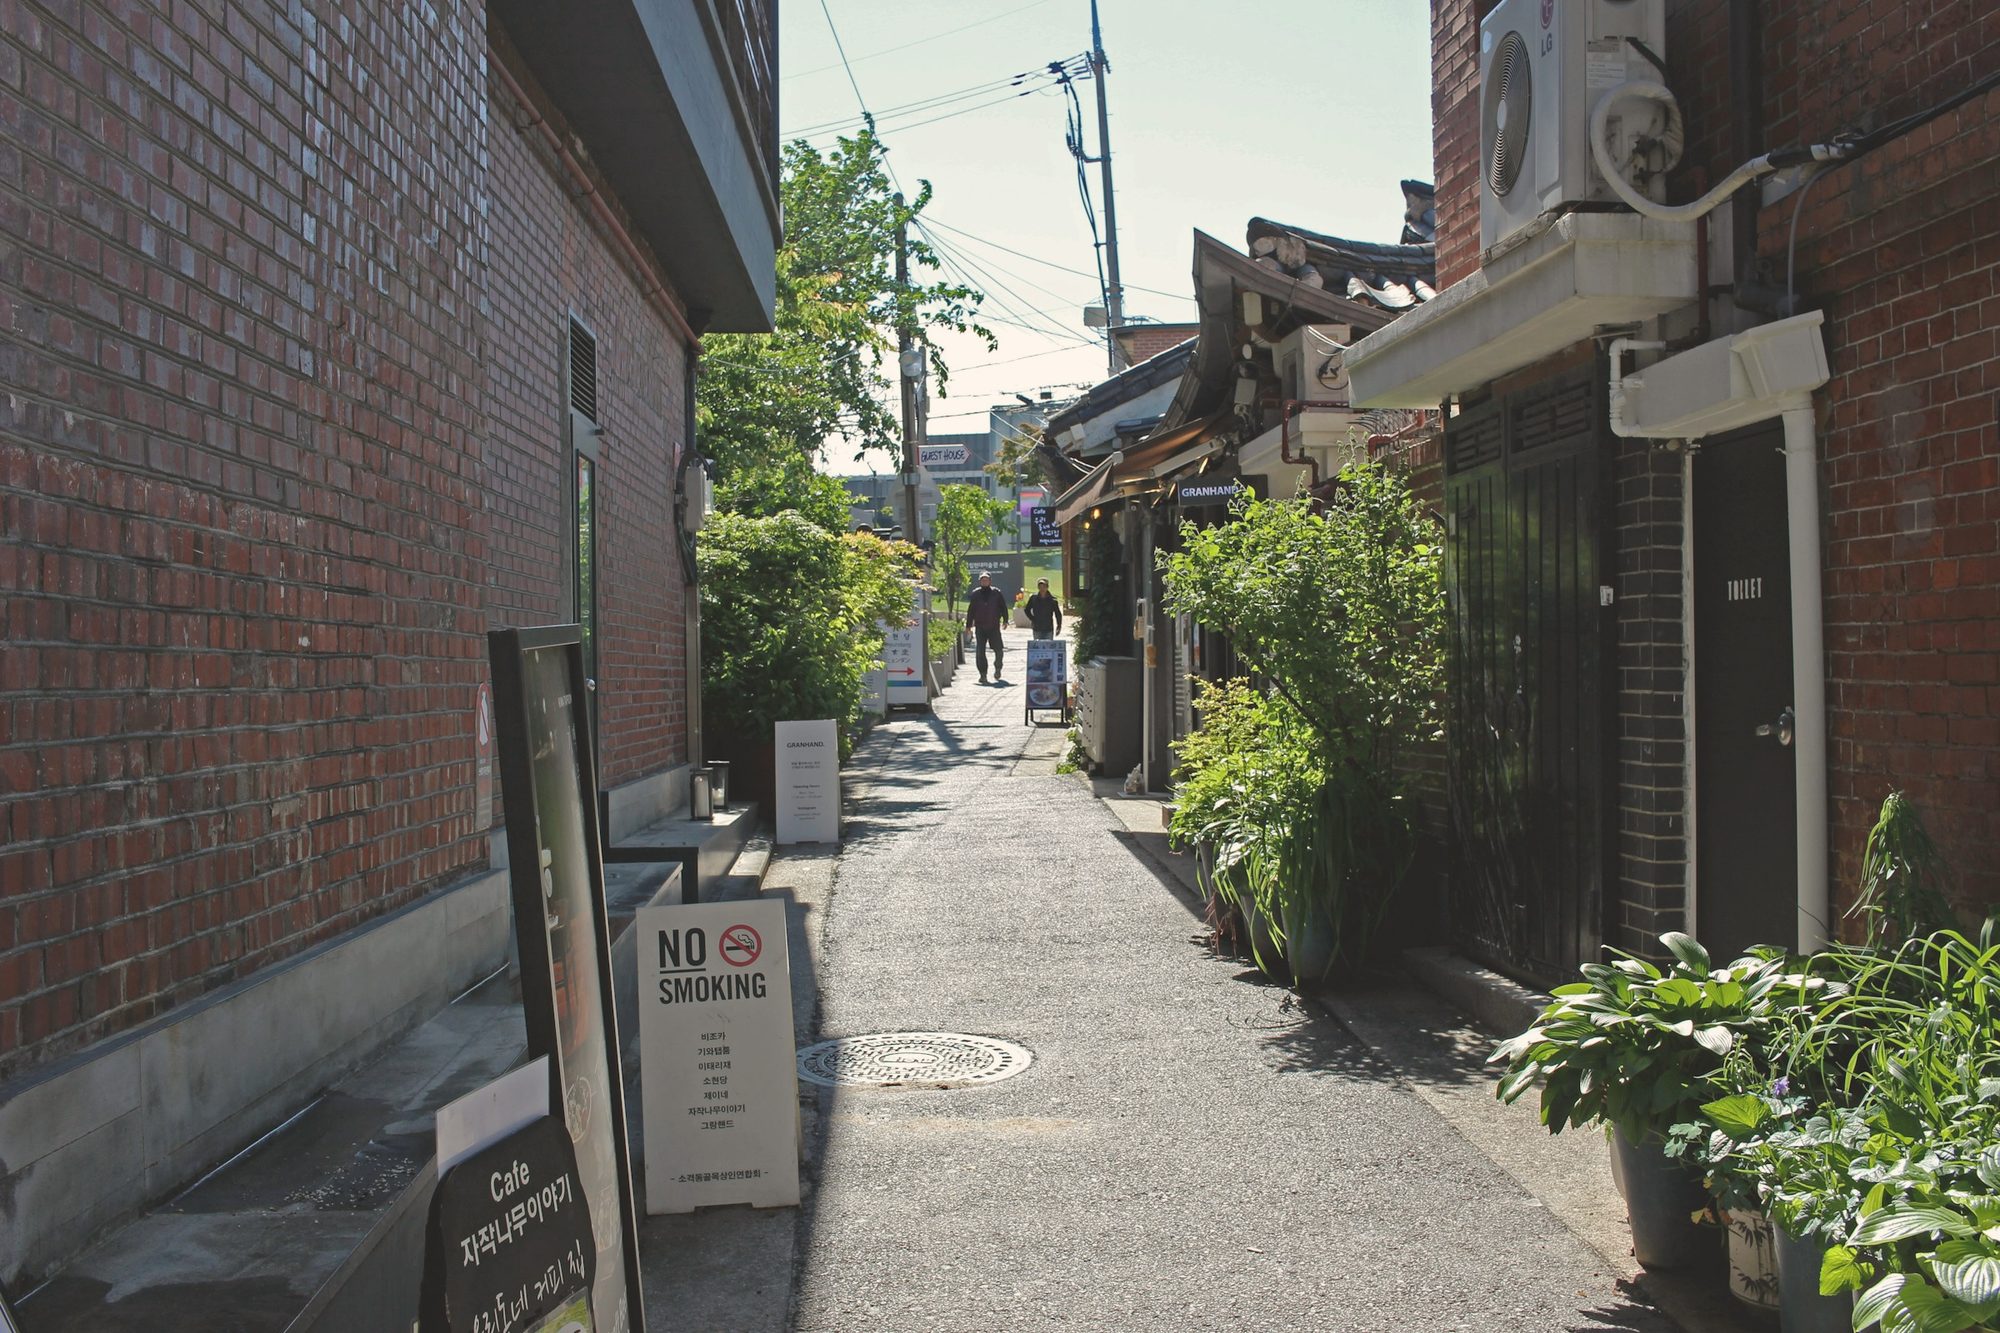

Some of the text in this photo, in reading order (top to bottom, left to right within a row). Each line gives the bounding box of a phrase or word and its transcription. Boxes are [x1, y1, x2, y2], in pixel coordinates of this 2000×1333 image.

[1541, 32, 1552, 58] LG
[921, 449, 965, 462] GUEST HOUSE
[1727, 577, 1762, 601] TOILET
[659, 927, 707, 968] NO
[659, 972, 767, 1005] SMOKING
[688, 1104, 746, 1116] 자작나무이야기
[490, 1159, 531, 1203] Cafe
[460, 1173, 573, 1267] 자작나무이야기
